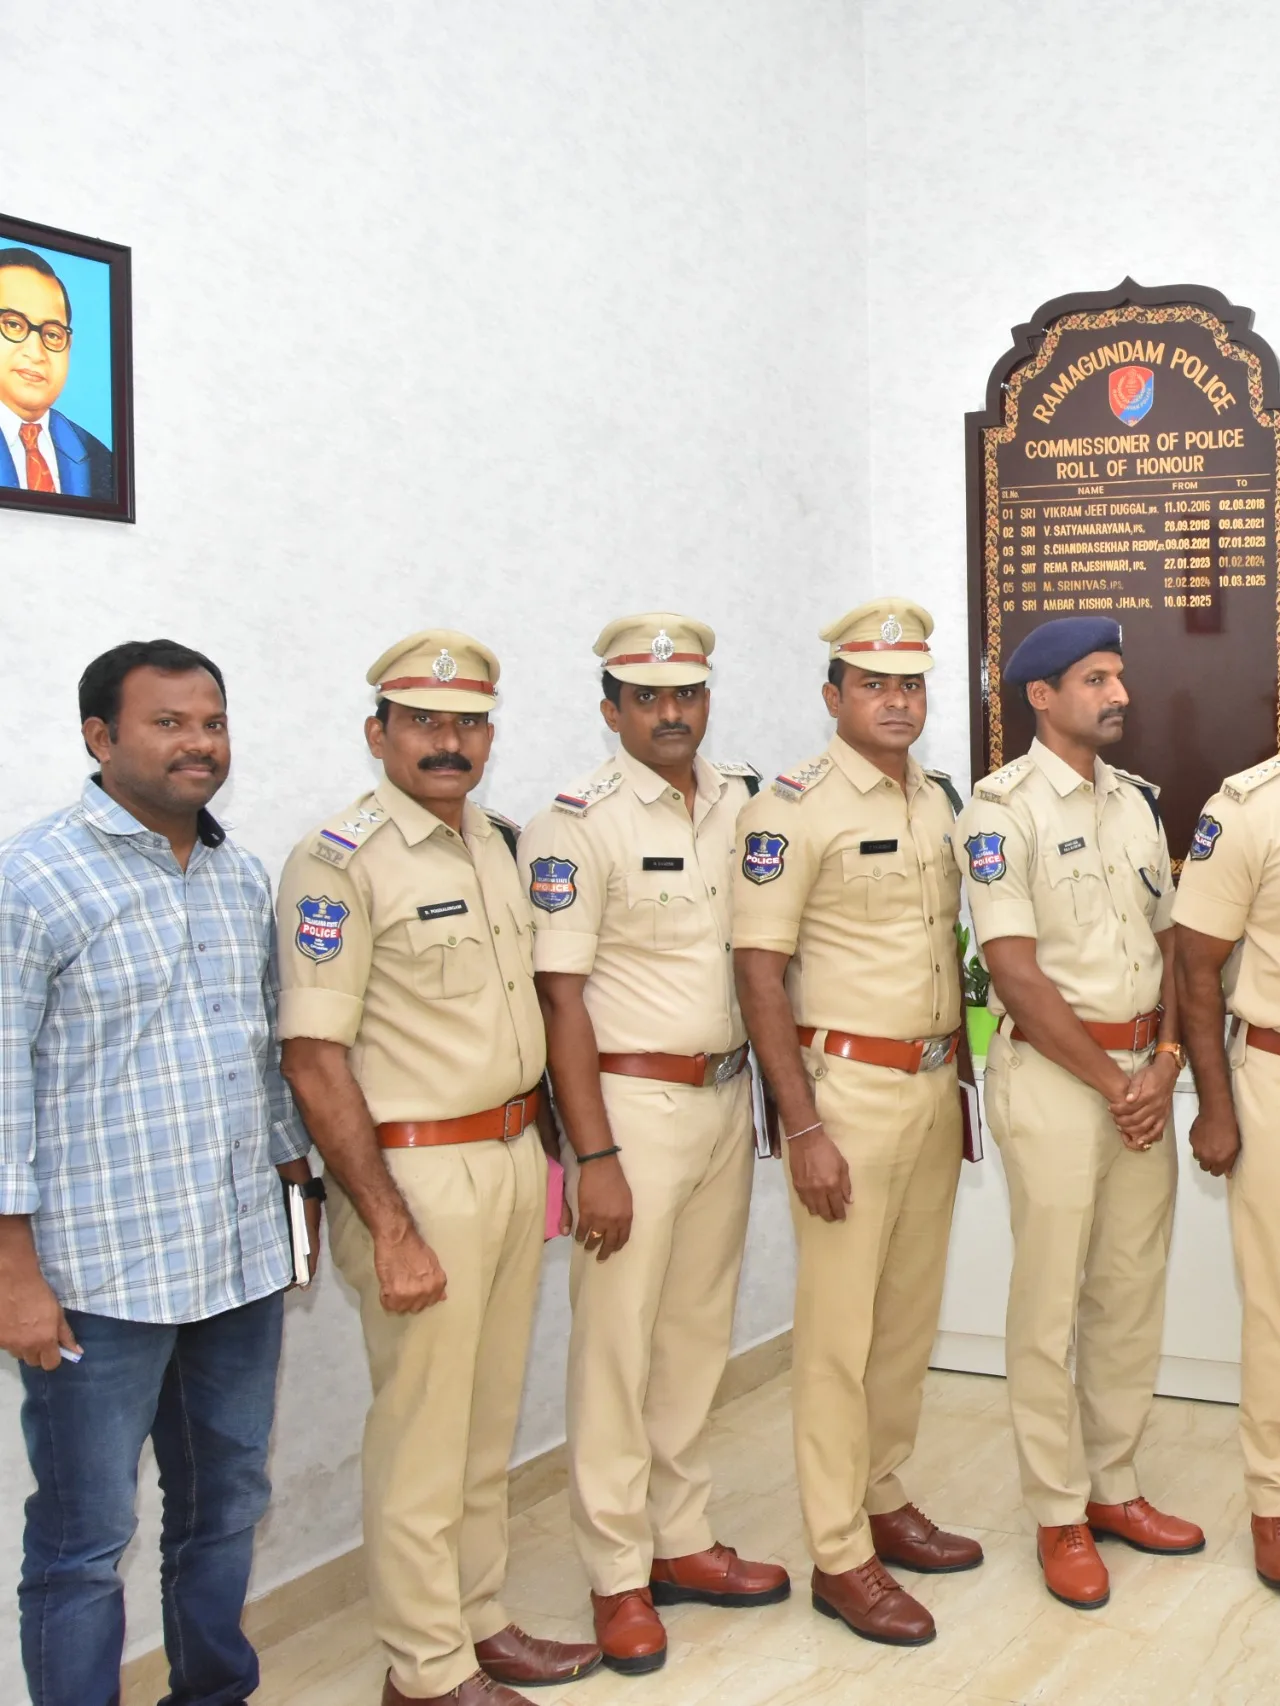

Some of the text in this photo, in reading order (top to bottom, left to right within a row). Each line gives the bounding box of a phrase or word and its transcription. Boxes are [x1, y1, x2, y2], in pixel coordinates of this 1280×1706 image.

[1032, 340, 1236, 424] RAMAGUNDAM POLICE
[1025, 428, 1245, 459] COMMISSIONER OF POLICE
[1056, 455, 1205, 480] ROLL OF HONOUR
[1077, 485, 1105, 495] NAME
[1172, 481, 1198, 490] FROM
[1236, 479, 1248, 487] TO
[1002, 508, 1013, 520] 01
[1020, 507, 1036, 519] SRI
[1043, 505, 1082, 518] VIKRAM
[1084, 503, 1108, 516] JEET
[1164, 500, 1211, 513] 11.10.2016
[1218, 498, 1266, 511] 02.09.2018
[1002, 526, 1014, 538] 02
[1020, 526, 1036, 538] SRI
[1002, 545, 1014, 557] 03
[1020, 544, 1036, 556] SRI
[1165, 537, 1211, 550] 09.08.2021
[1218, 535, 1266, 549] 07.01.2023
[1003, 563, 1015, 575] 04
[1021, 562, 1036, 574] SMT
[1043, 561, 1069, 573] REMA
[1164, 556, 1211, 570] 27.01.2023
[1218, 554, 1265, 568] 01.02.2024
[1003, 582, 1015, 594] 05
[1021, 581, 1036, 593] SRI
[1042, 581, 1055, 592] M.
[1164, 576, 1211, 589] 12.02.2024
[1218, 574, 1266, 587] 10.03.2025
[1003, 600, 1015, 612] 06
[1022, 599, 1037, 612] SRI
[1043, 598, 1075, 611] AMBAR
[1079, 597, 1113, 610] KISHOR
[1164, 594, 1212, 608] 10.03.2025
[746, 854, 780, 865] POLICE
[973, 855, 1000, 867] POLICE
[536, 883, 569, 893] POLICE
[302, 924, 337, 938] POLICE
